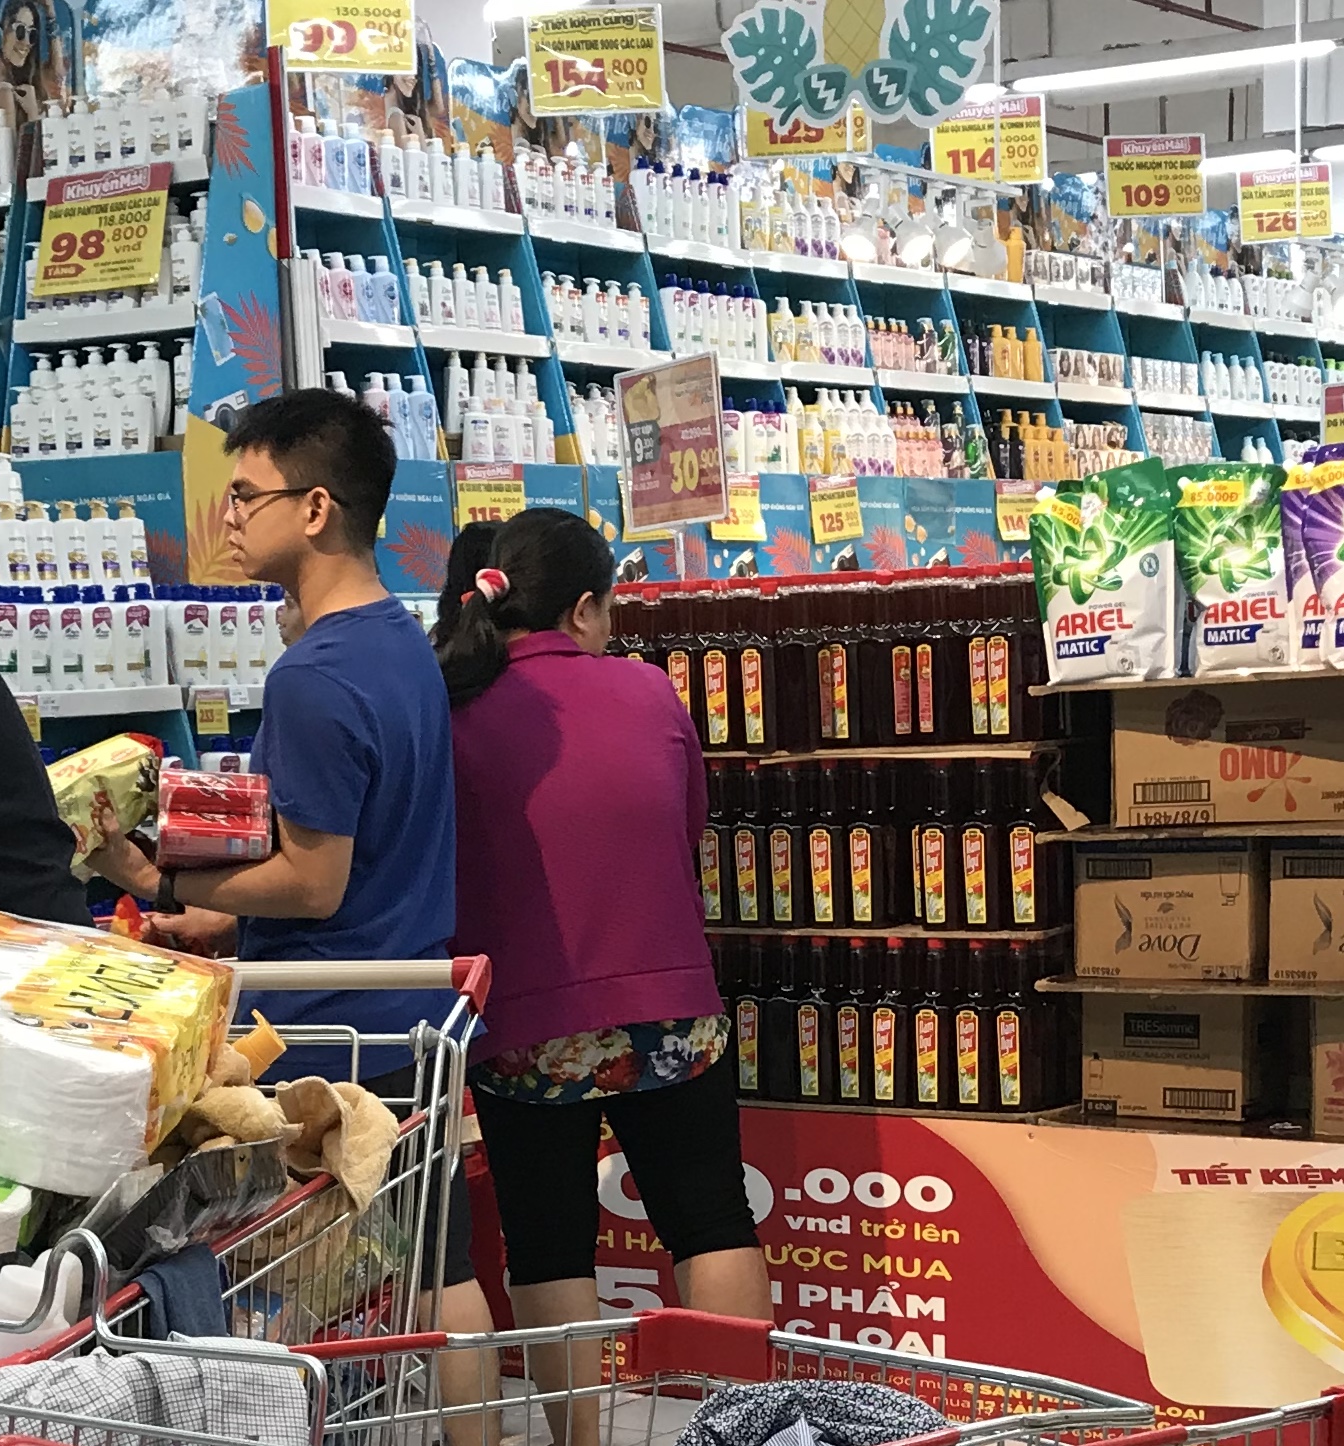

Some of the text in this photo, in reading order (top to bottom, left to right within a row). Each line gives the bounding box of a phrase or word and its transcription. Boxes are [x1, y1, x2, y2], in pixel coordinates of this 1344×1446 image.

[544, 58, 609, 97] 154
[946, 146, 1002, 174] 114
[1121, 184, 1170, 207] 109
[1253, 211, 1296, 233] 126
[50, 229, 105, 263] 98
[634, 437, 644, 463] 9
[669, 447, 700, 494] 30
[819, 511, 844, 534] 125
[1056, 608, 1133, 638] ARIEL
[1204, 598, 1286, 625] ARIEL
[1059, 639, 1100, 656] MATIC
[1207, 627, 1251, 644] MATIC
[1219, 745, 1287, 782] OMO
[1138, 933, 1201, 961] Dove
[1170, 1161, 1260, 1187] TIẾT
[784, 1167, 954, 1213] .000
[783, 1213, 960, 1245] vnd trở lên
[764, 1243, 954, 1282] ƯỢC MUA
[798, 1281, 946, 1322] PHẨM
[1155, 1404, 1205, 1423] LOẠI
